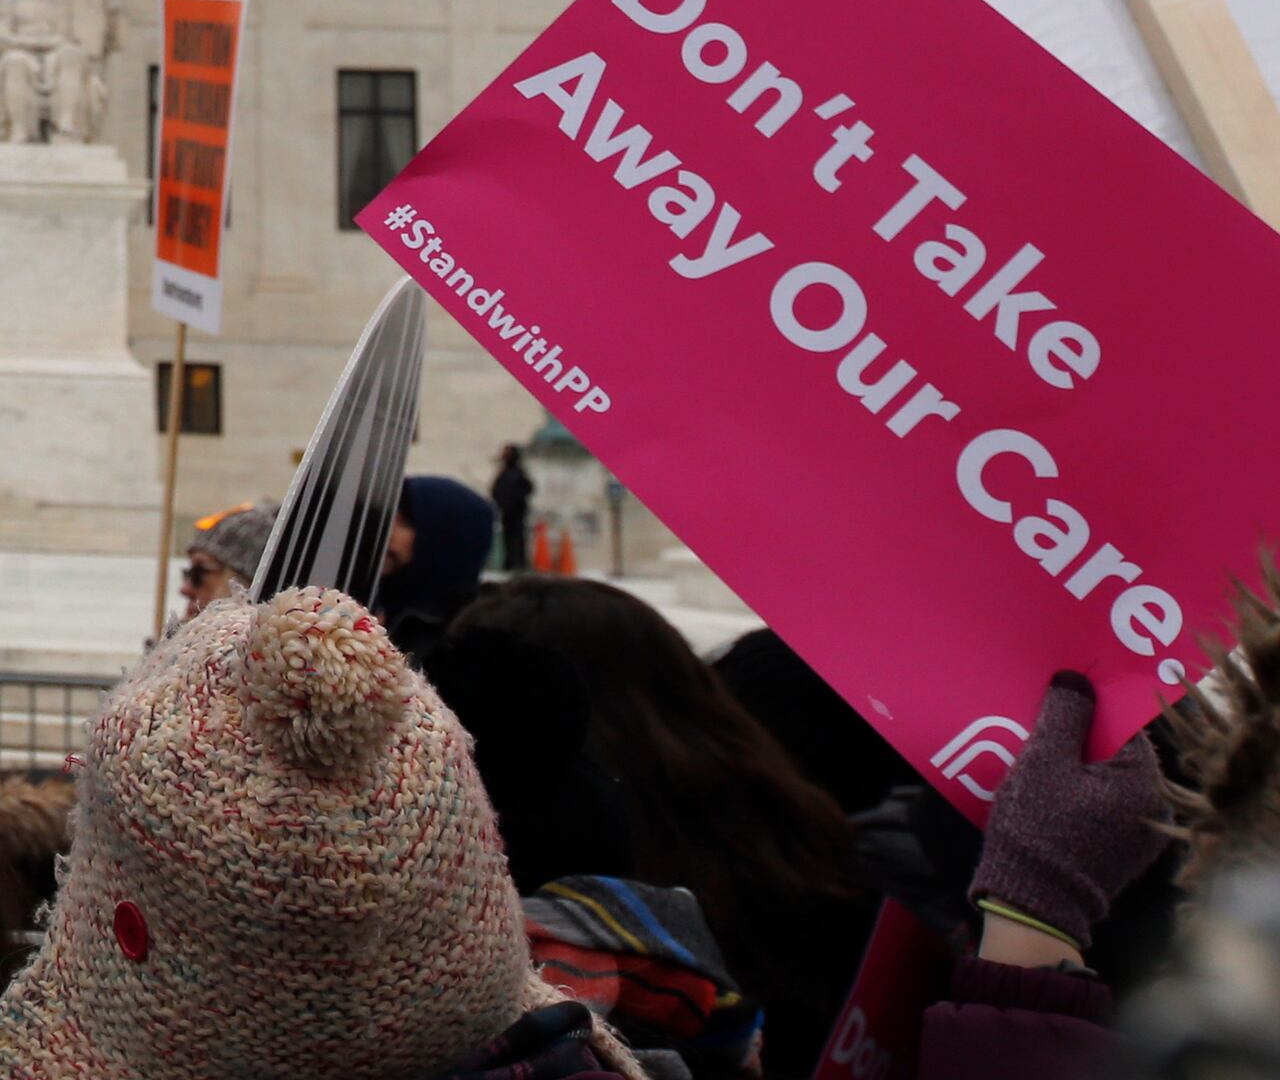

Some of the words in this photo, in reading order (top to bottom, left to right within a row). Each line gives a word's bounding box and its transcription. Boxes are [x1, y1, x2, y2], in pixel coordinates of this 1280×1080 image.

[383, 204, 612, 413] #StandwithPP
[513, 50, 775, 280] Away
[769, 260, 962, 440] Our
[955, 428, 1186, 688] Care.
[871, 154, 1102, 390] Take
